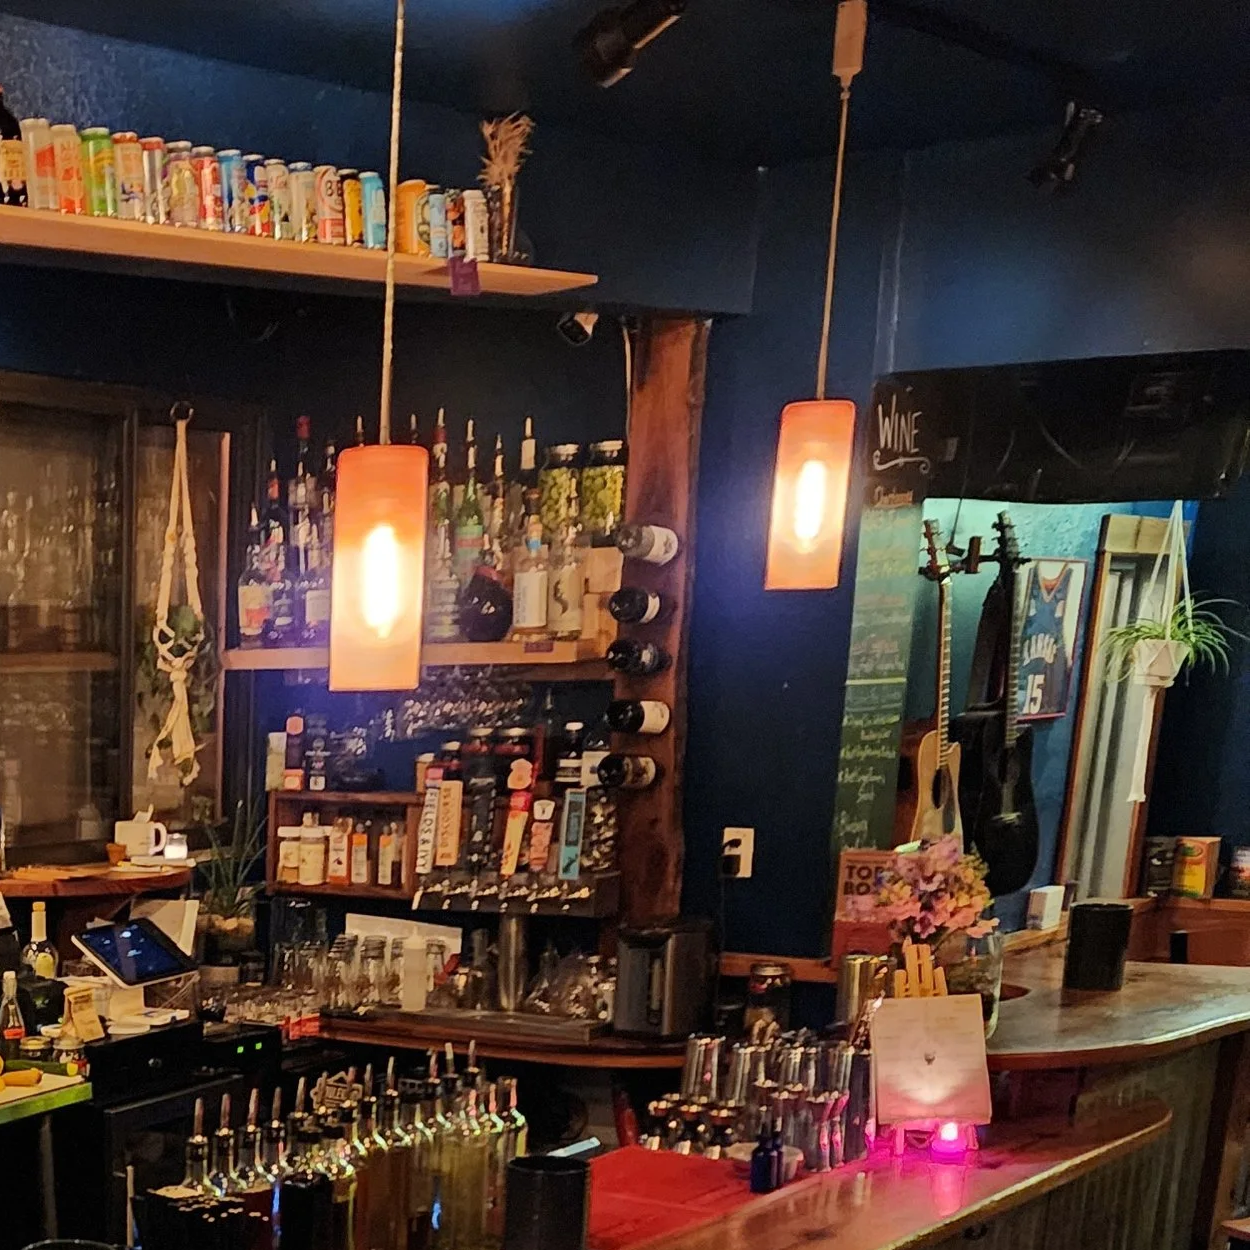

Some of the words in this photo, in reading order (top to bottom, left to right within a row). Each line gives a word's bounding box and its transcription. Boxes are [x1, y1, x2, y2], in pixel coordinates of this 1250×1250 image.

[878, 393, 922, 453] WINE
[1022, 674, 1045, 714] 15
[420, 791, 439, 834] FIELDS
[417, 850, 430, 868] IVY
